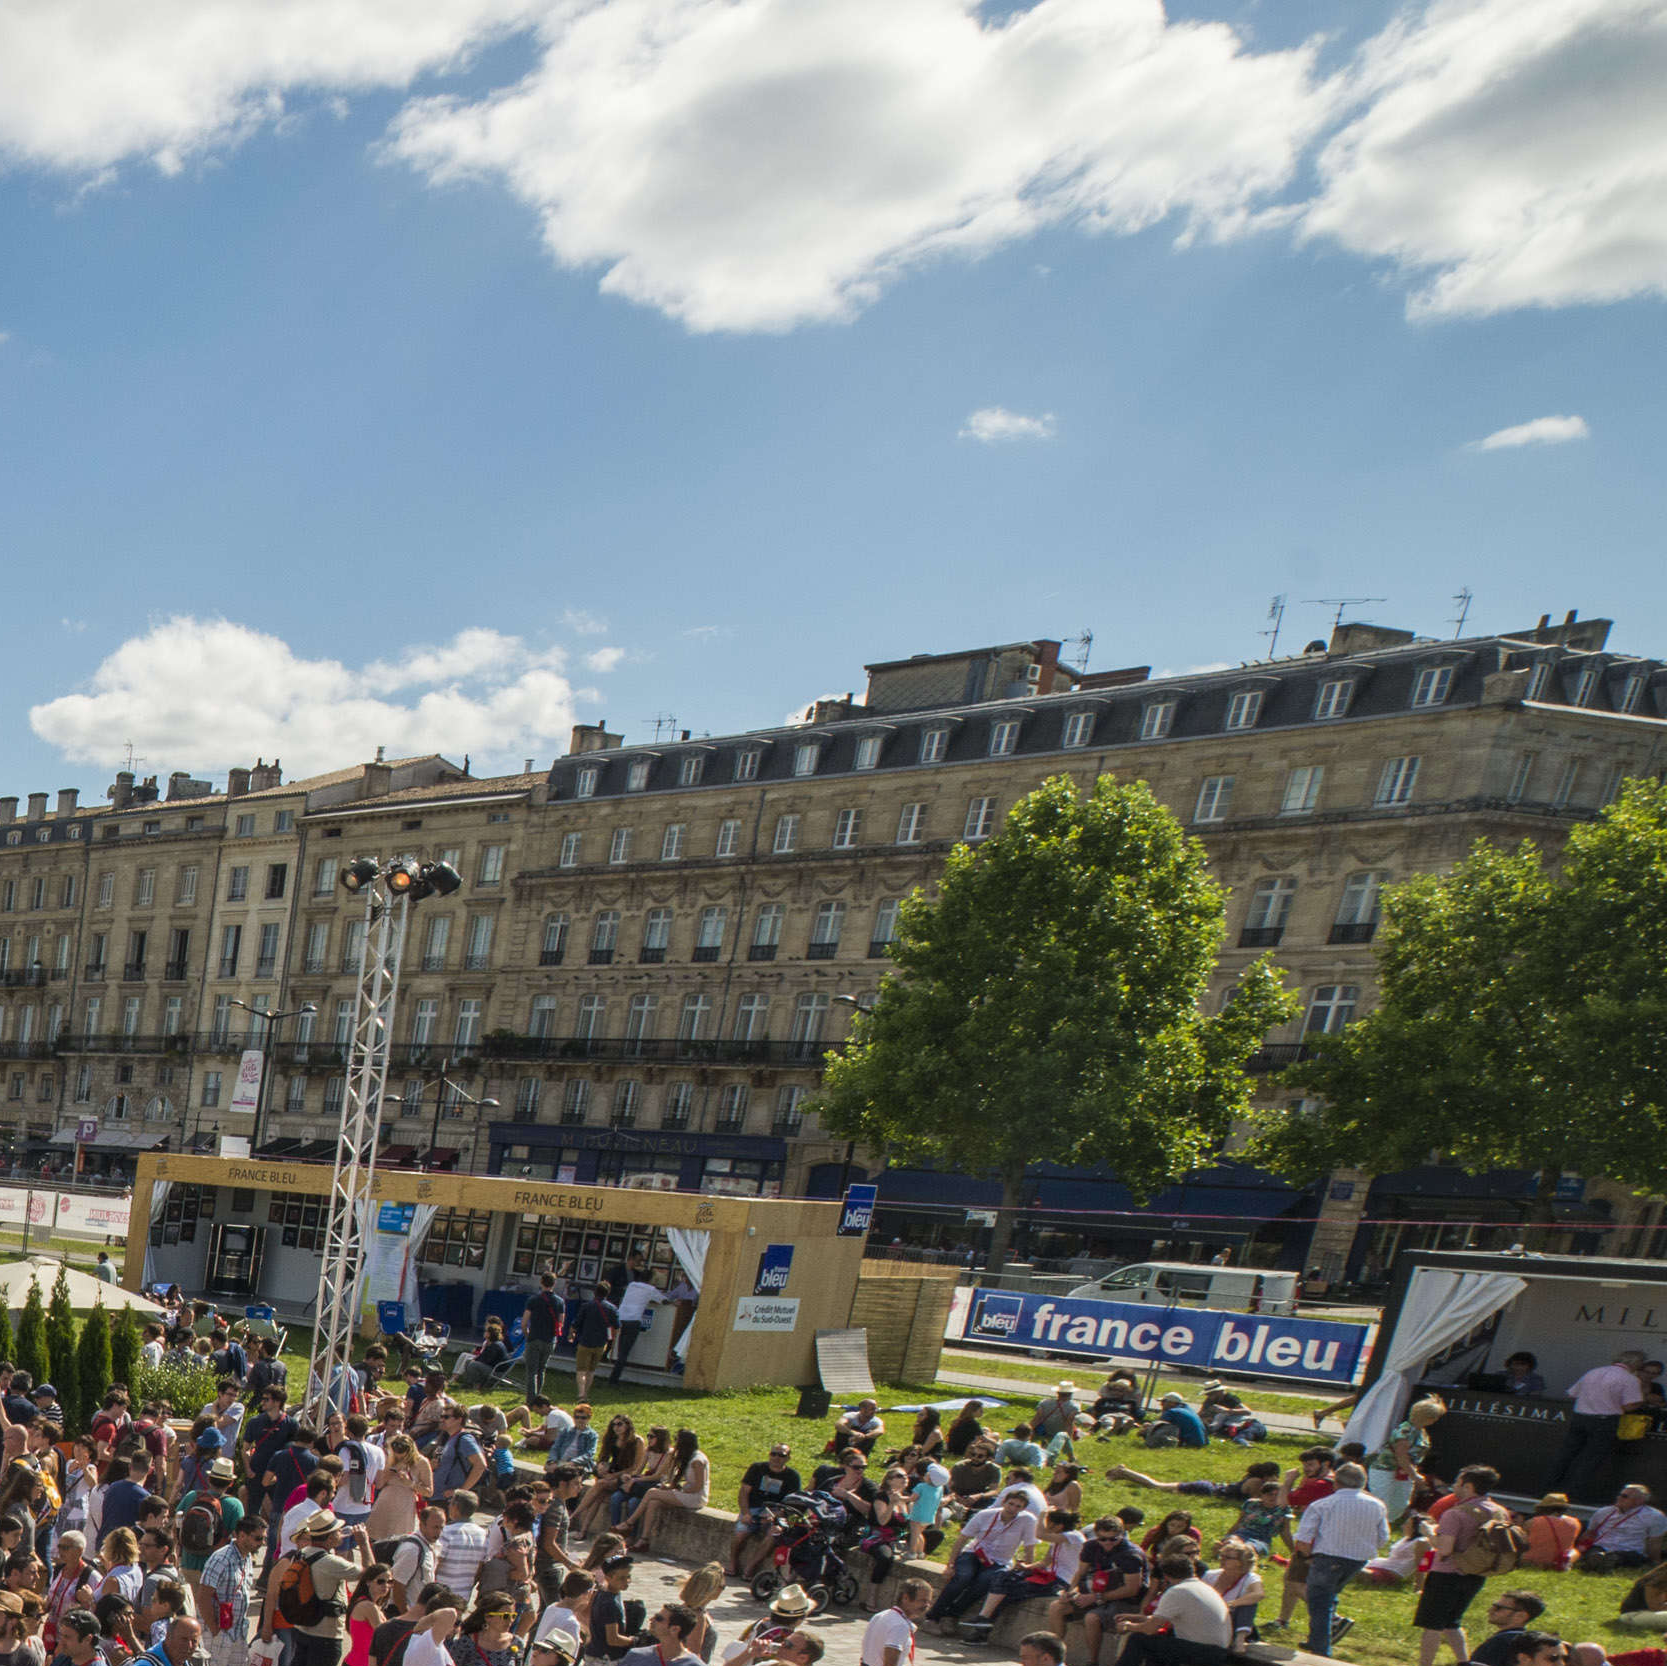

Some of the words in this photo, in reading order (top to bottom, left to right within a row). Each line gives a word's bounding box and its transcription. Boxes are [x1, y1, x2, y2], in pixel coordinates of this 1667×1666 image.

[228, 1167, 267, 1182] FRANCE
[269, 1170, 297, 1185] BLEU
[514, 1191, 566, 1208] FRANCE
[568, 1194, 604, 1211] BLEU
[844, 1209, 871, 1228] bleu
[761, 1269, 788, 1288] bleu
[752, 1315, 760, 1323] du
[761, 1315, 792, 1324] Sud-Ouest
[981, 1312, 1016, 1332] bleu
[1032, 1303, 1195, 1356] france
[1213, 1321, 1341, 1372] bleu
[1448, 1399, 1567, 1422] ILLÉSIMA
